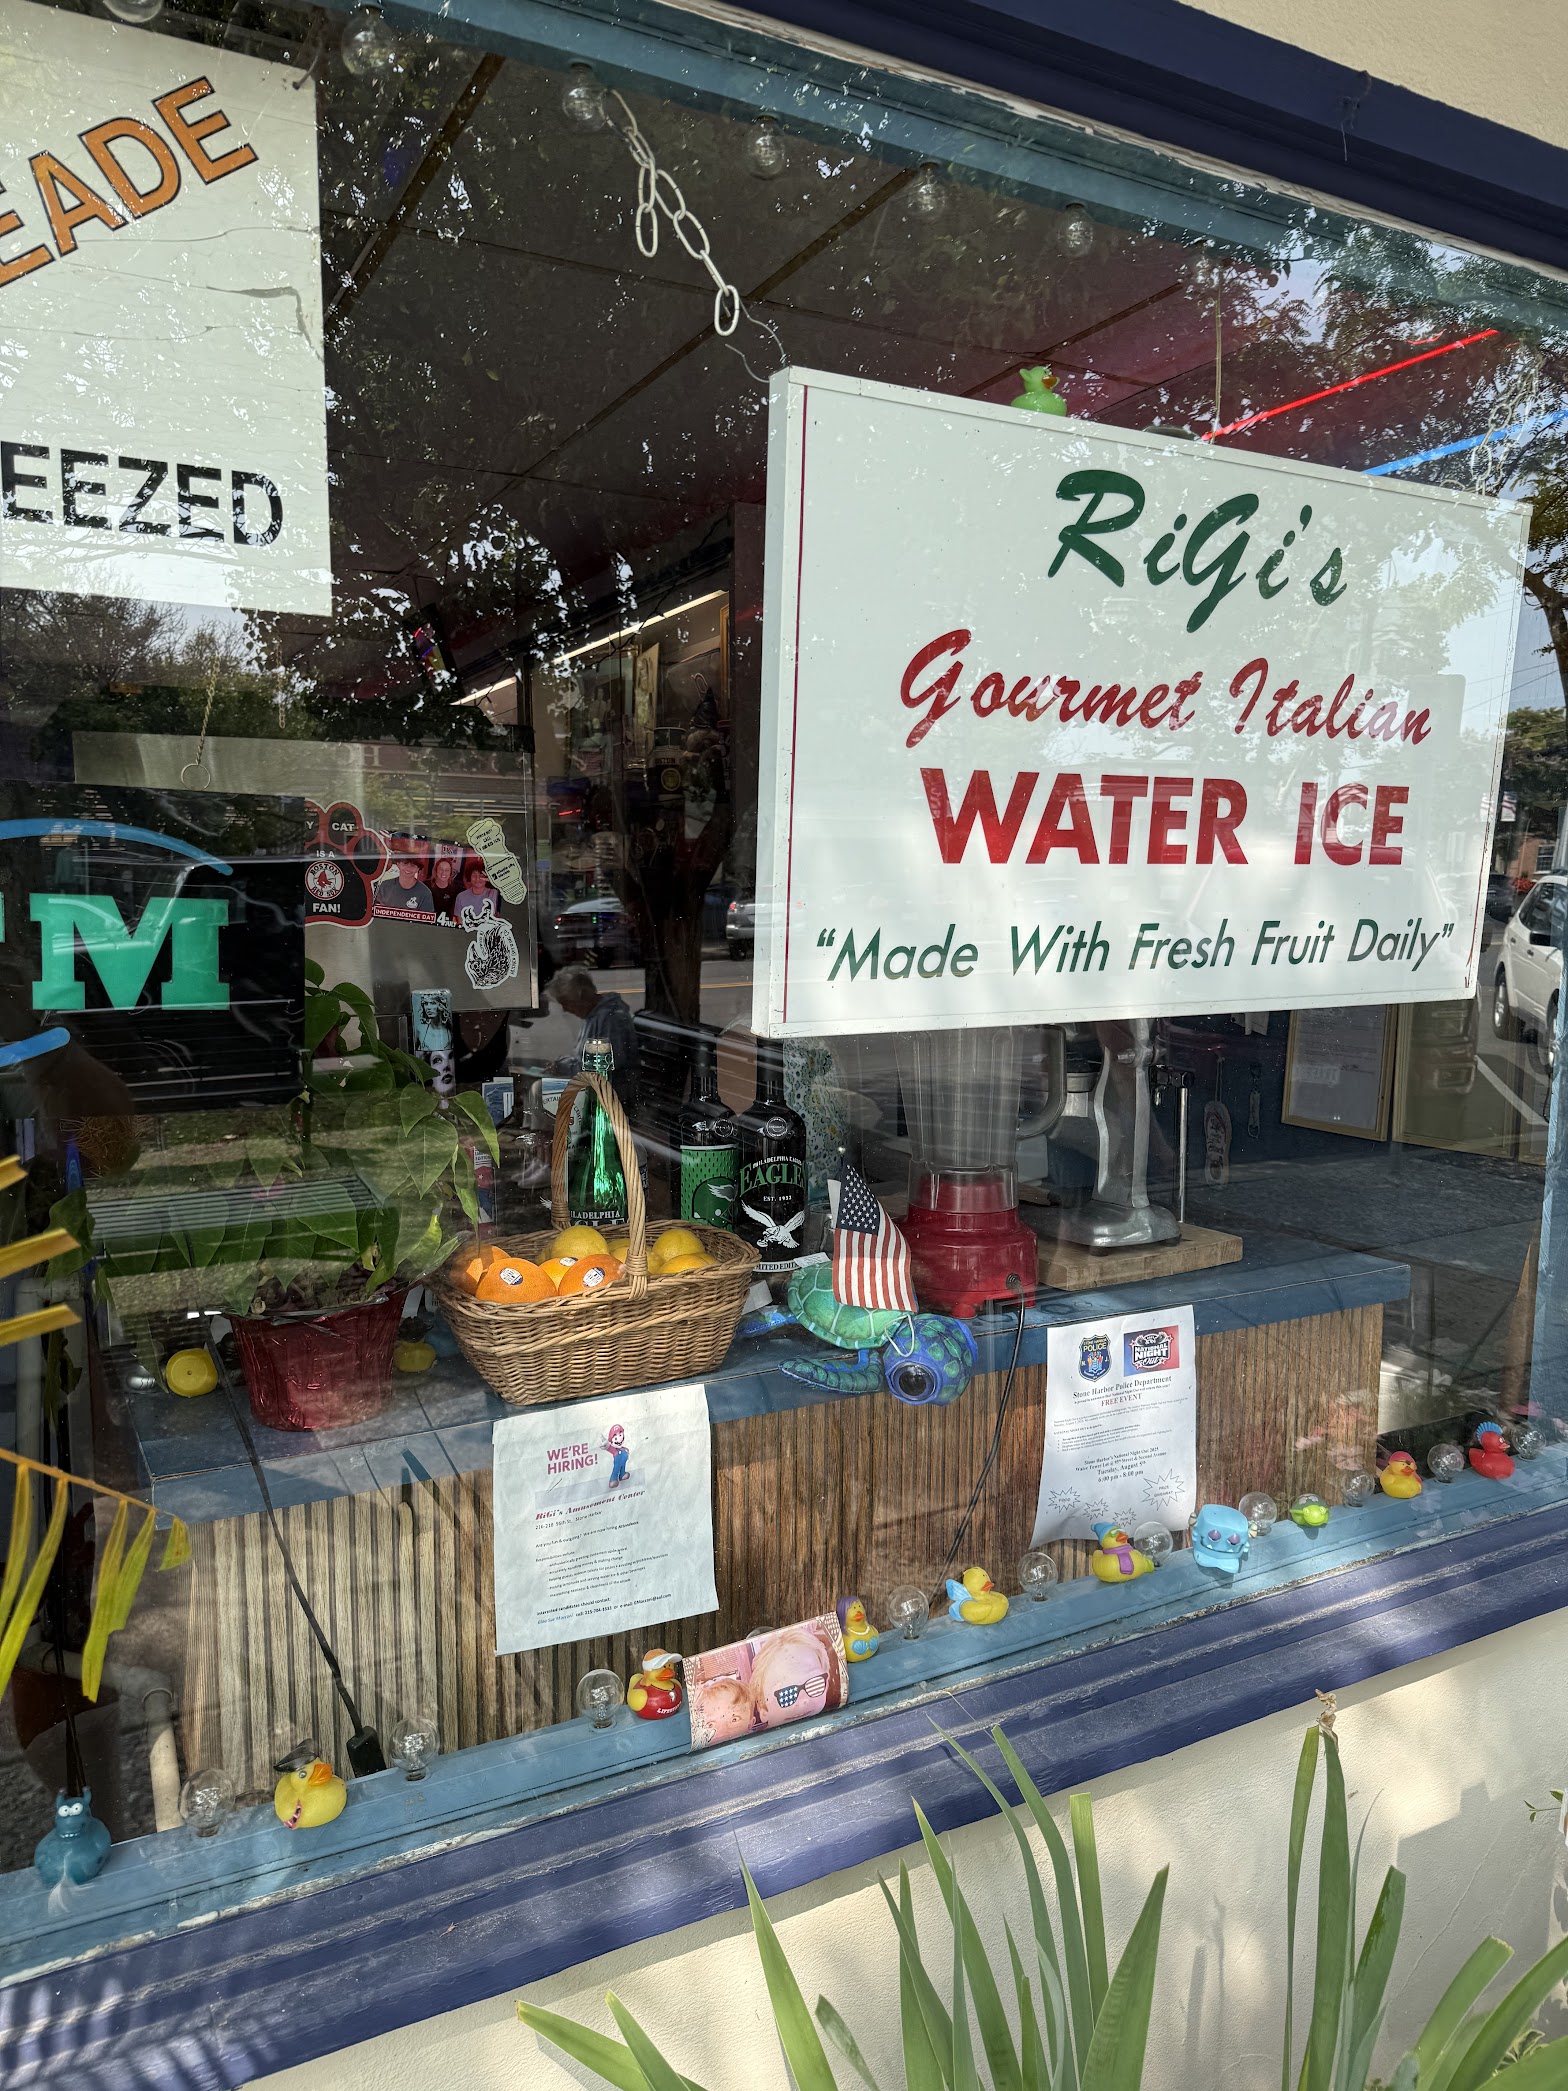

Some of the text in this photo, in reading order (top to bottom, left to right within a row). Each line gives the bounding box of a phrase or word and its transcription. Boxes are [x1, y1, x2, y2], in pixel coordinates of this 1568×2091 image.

[1, 441, 283, 547] EEZED
[1047, 468, 1348, 634] RiGi's
[900, 628, 1432, 749] Gourmet Italian
[920, 767, 1410, 866] WATER ICE
[332, 823, 354, 832] CAT
[310, 864, 340, 876] BOSTON
[311, 886, 339, 897] RED SOX
[312, 903, 341, 913] FAN!
[375, 908, 421, 919] INDEPENDENCE
[0, 893, 230, 1010] M
[1010, 920, 1110, 976] With
[1127, 920, 1238, 971] Fresh
[1251, 917, 1334, 967] Fruit
[752, 1156, 788, 1169] PHILADELPHIA
[570, 1210, 620, 1219] ILADELPHIA
[1083, 1343, 1106, 1352] POLICE
[1135, 1343, 1168, 1353] NATIONAL
[1135, 1348, 1168, 1361] NIGHT
[1073, 1375, 1172, 1399] Stone Harbor Police Department
[1102, 1393, 1142, 1406] FREE EVENT
[547, 1443, 589, 1461] WE'RE
[547, 1453, 599, 1475] HIRING!
[1097, 1466, 1119, 1476] Tuesday,
[566, 1496, 615, 1516] Amusement
[618, 1489, 646, 1500] Center
